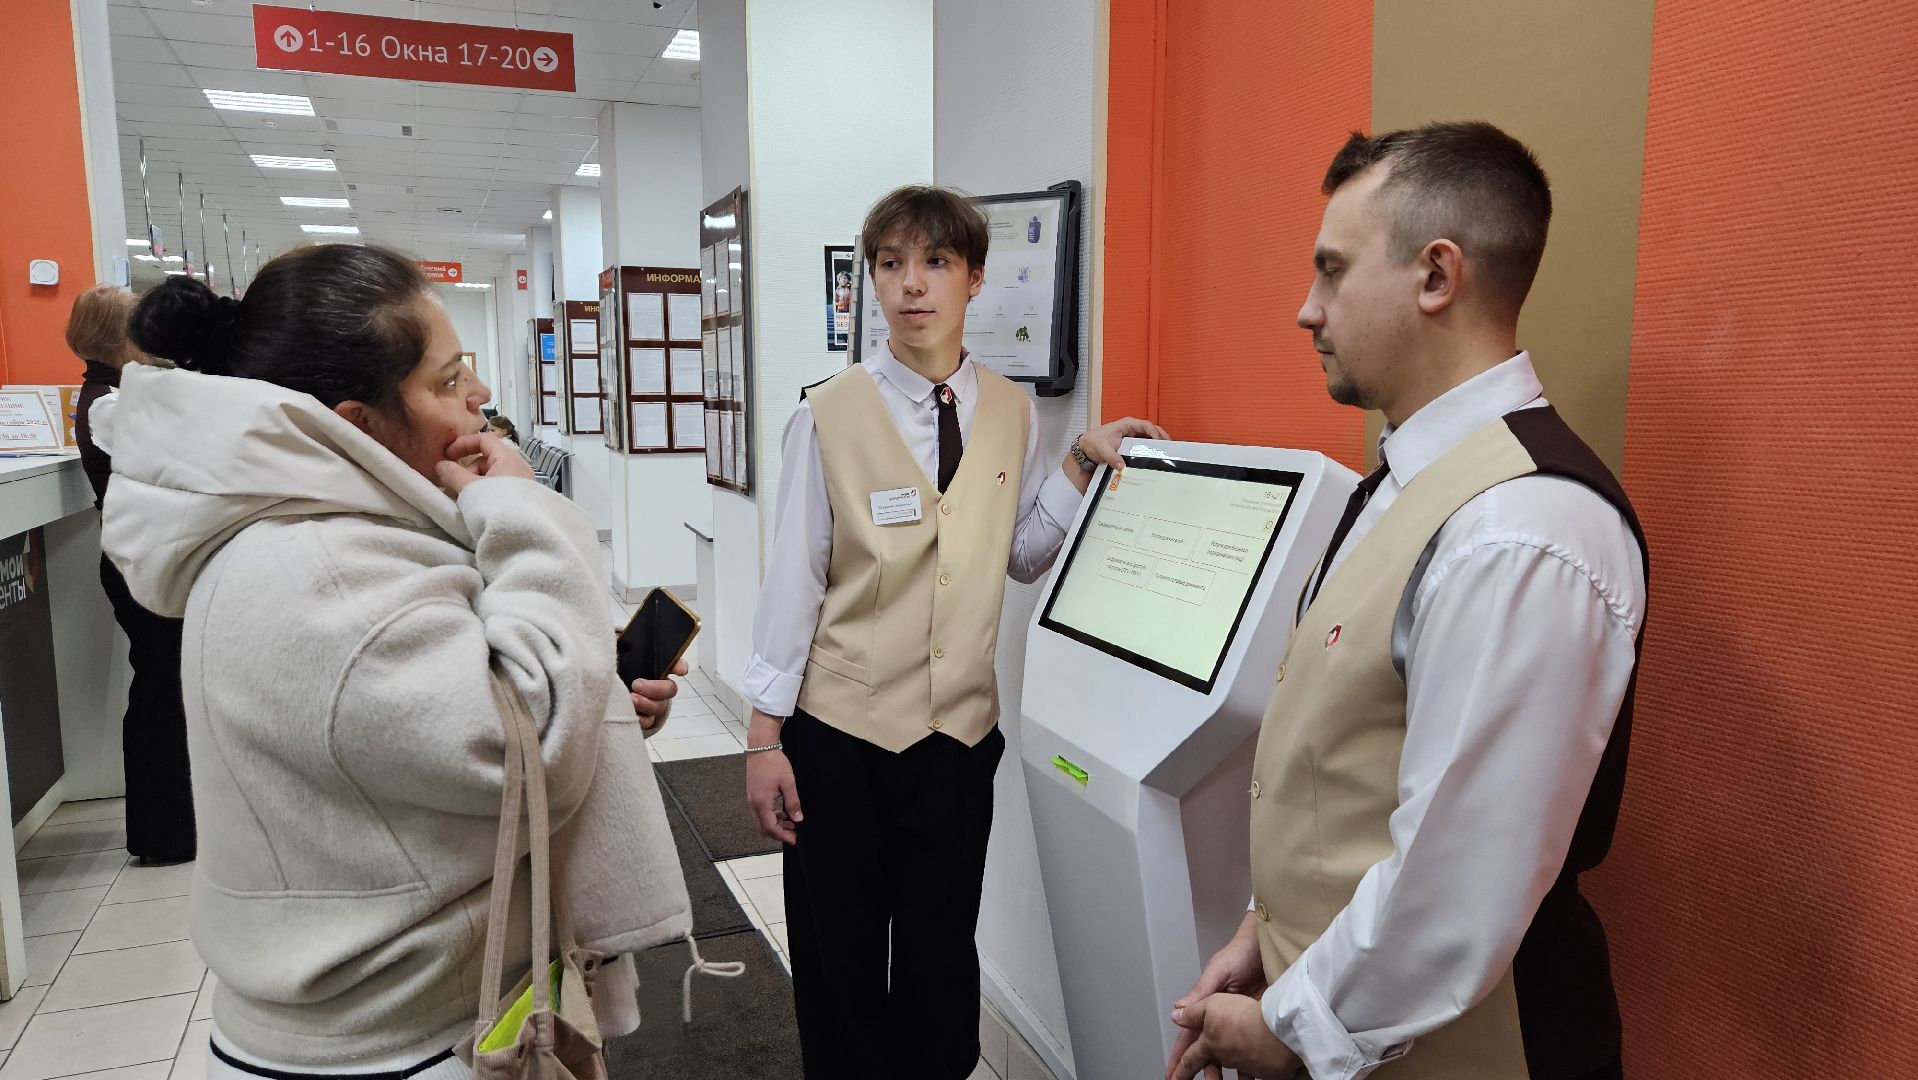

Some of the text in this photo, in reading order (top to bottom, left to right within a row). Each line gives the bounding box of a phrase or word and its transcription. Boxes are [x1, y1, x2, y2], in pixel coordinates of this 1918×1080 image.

[307, 28, 531, 71] 1-16 Окна 17-20
[646, 273, 701, 284] ИНФОРМА
